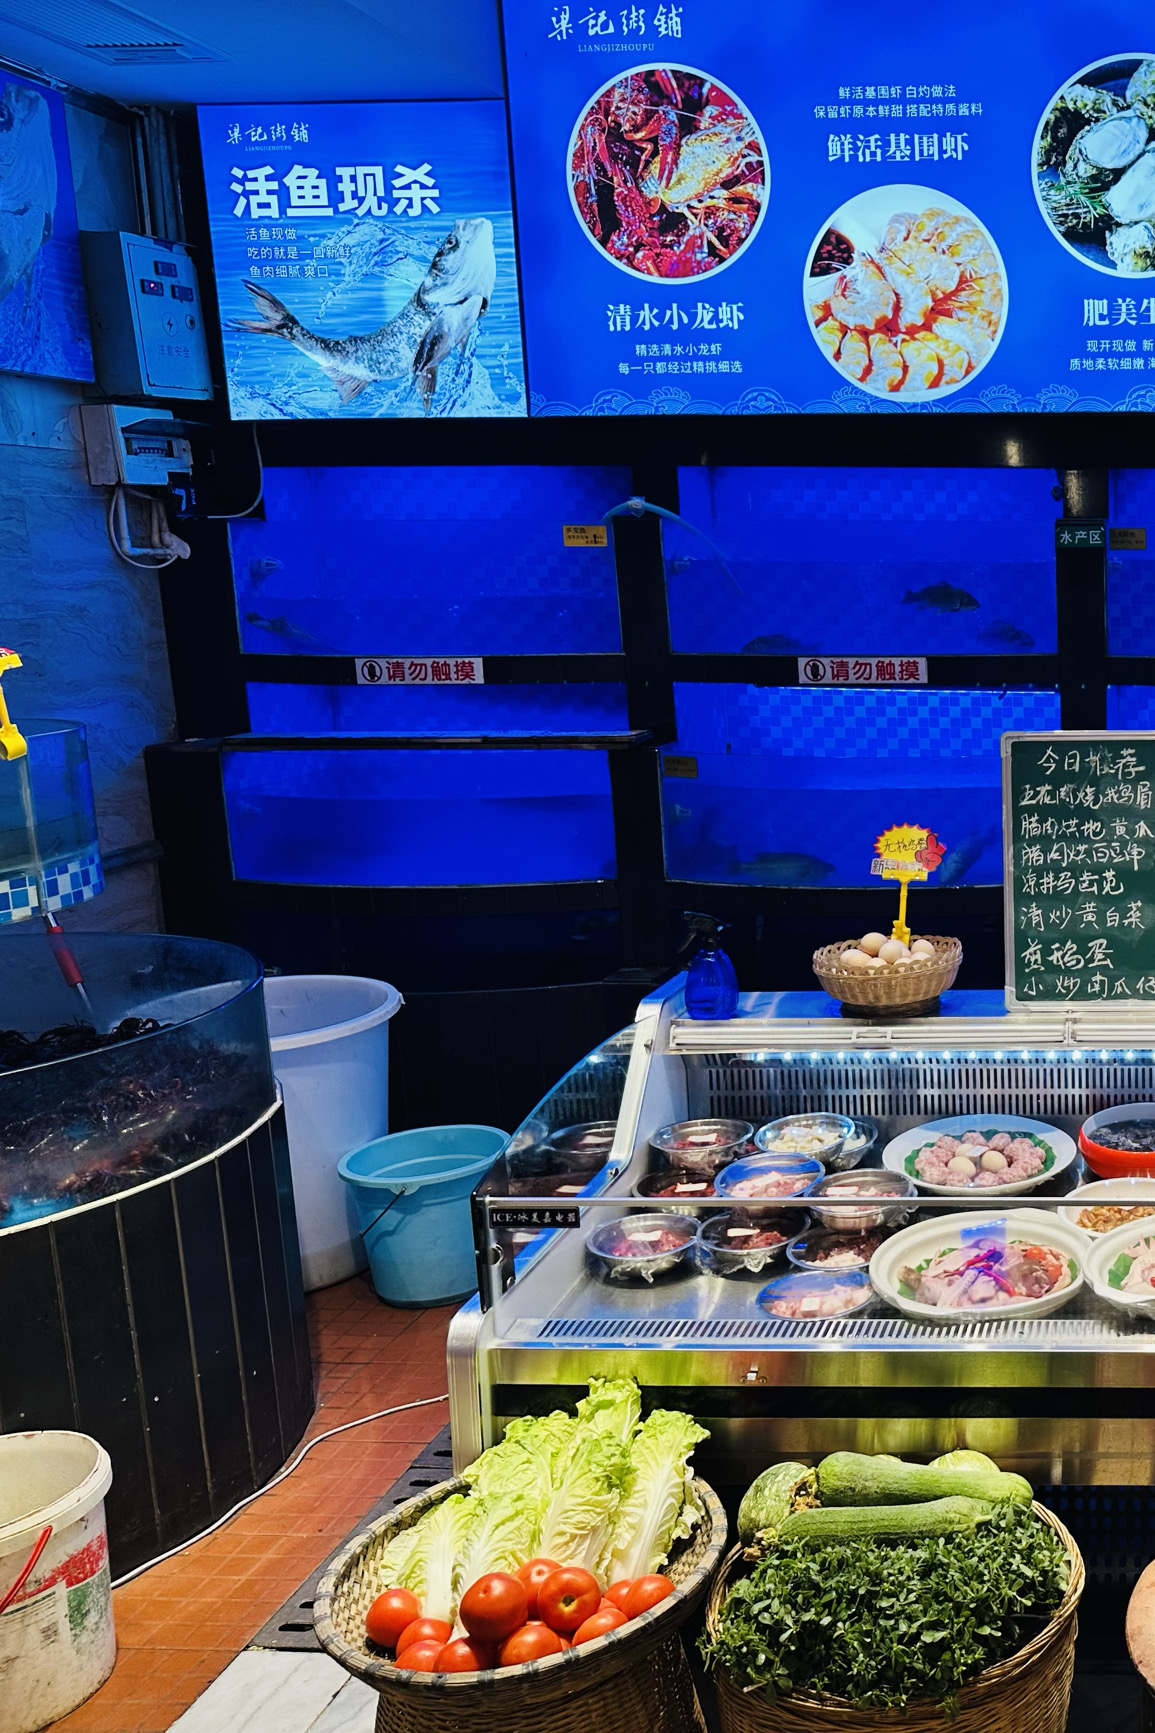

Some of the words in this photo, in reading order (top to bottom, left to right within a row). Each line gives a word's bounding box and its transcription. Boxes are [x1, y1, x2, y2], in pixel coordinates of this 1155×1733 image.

[578, 43, 655, 53] LIANGJIZHOUPU
[838, 85, 903, 100] 鲜活基围虾
[905, 84, 957, 99] 白灼做法
[813, 104, 903, 119] 保留虾原本鲜甜
[905, 102, 983, 118] 搭配特质酱料
[827, 131, 969, 163] 鲜活基围虾
[229, 162, 441, 219] 活鱼现杀
[245, 227, 297, 241] 活鱼现做
[247, 245, 351, 260] 吃的就是一口新鲜
[249, 265, 301, 278] 鱼肉细腻
[304, 265, 329, 278] 爽口
[606, 301, 745, 332] 清水小龙虾
[635, 342, 722, 357] 精选清水小龙虾
[1086, 339, 1137, 353] 现开现做
[618, 360, 743, 375] 每一只都经过精挑细选
[1069, 357, 1145, 371] 质地柔软细嫩
[1060, 530, 1102, 544] 水产区
[388, 660, 475, 681] 请勿触摸
[831, 660, 918, 681] 请勿触摸
[1037, 746, 1146, 780] 今日推荐
